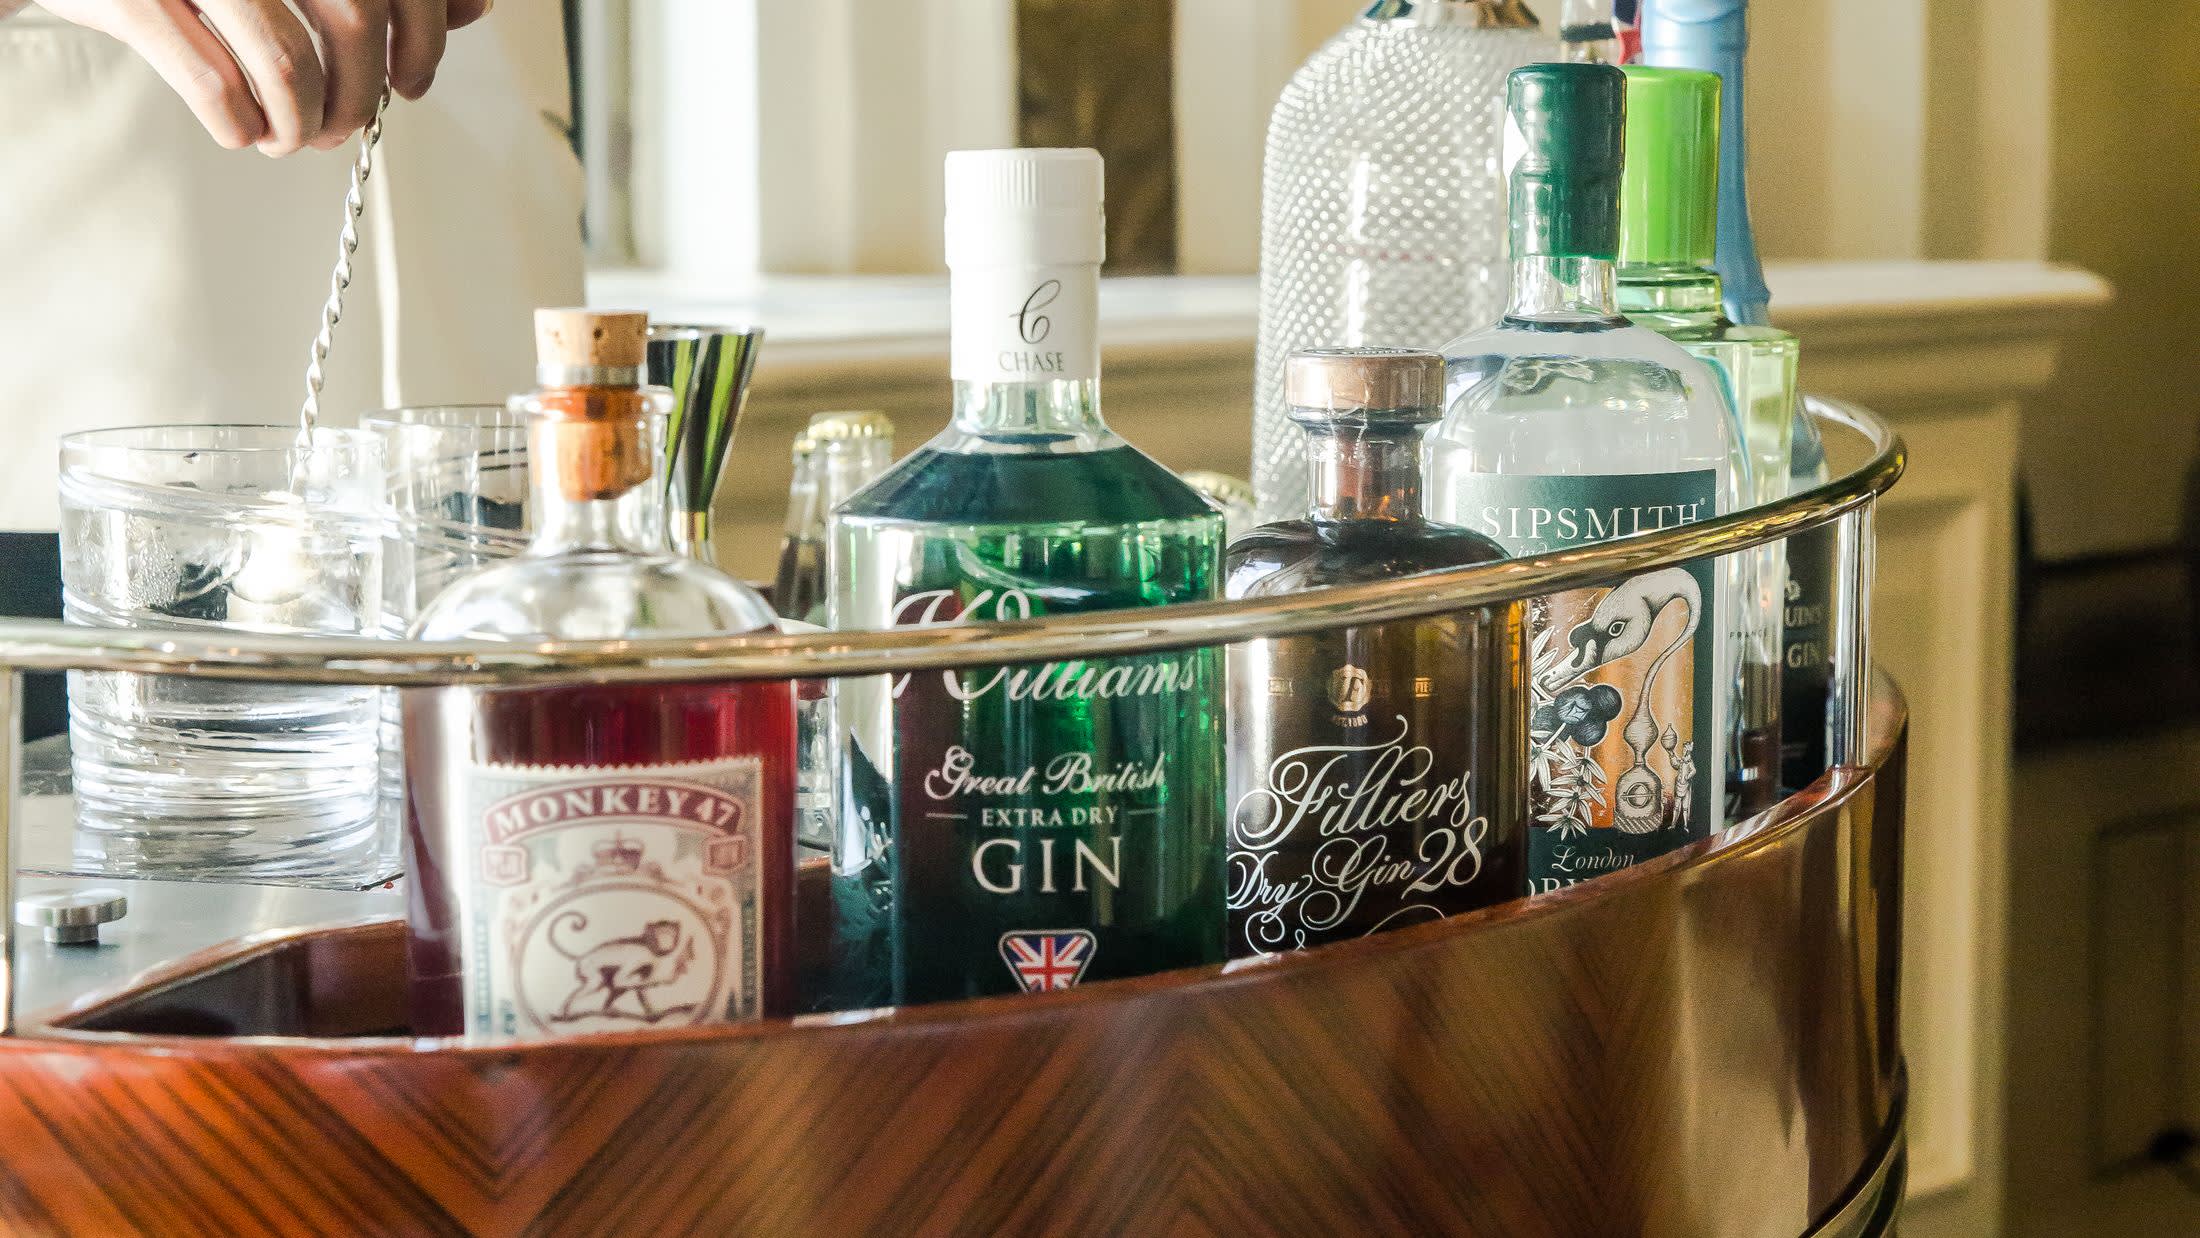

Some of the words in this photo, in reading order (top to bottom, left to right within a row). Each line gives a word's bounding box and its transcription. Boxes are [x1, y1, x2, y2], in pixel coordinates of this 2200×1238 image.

[999, 351, 1065, 372] CHASE
[1481, 503, 1699, 539] SIPSMITH
[924, 745, 1037, 801] Great
[1043, 751, 1167, 795] British
[1233, 715, 1470, 850] Filliers
[494, 785, 690, 837] MONKEY
[695, 797, 737, 827] 47
[981, 807, 1064, 827] EXTRA
[1072, 805, 1120, 826] DRY
[972, 836, 1123, 895] GIN
[1227, 851, 1313, 926] Dry
[1300, 835, 1415, 931] Gin
[1401, 816, 1488, 900] 28
[1552, 844, 1635, 873] London
